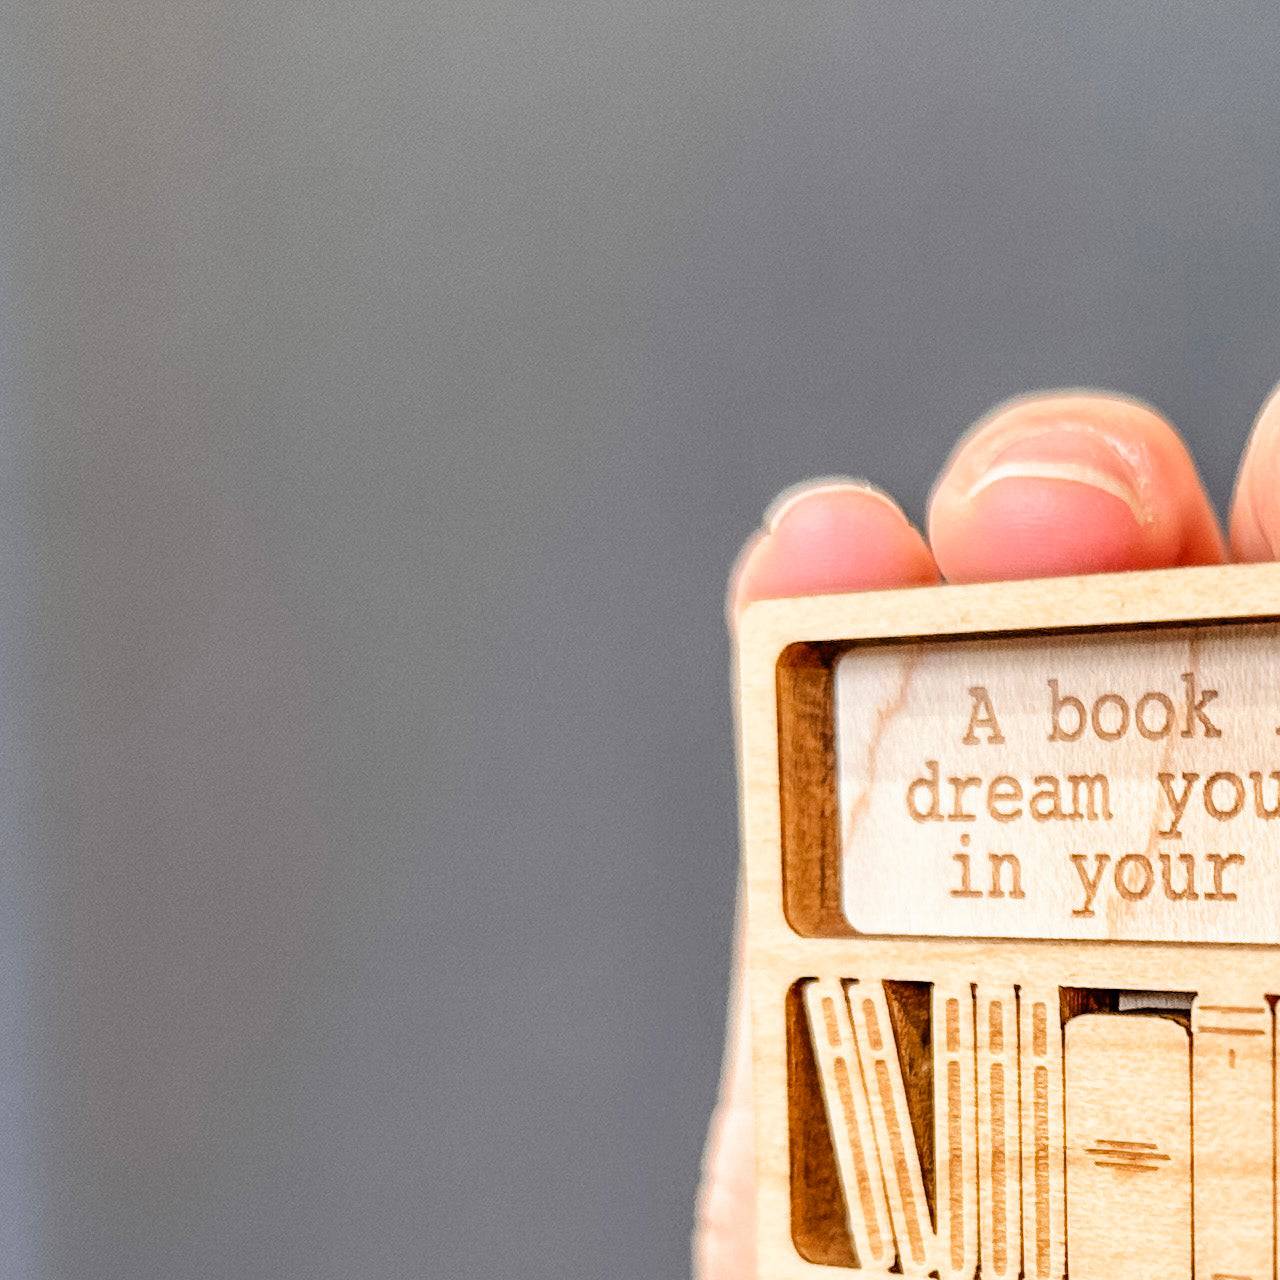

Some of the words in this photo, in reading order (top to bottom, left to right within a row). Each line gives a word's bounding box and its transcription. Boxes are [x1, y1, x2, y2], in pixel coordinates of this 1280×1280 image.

[961, 686, 1006, 746] A
[1047, 673, 1222, 744] book
[905, 760, 1114, 826] dream
[948, 834, 1026, 901] in
[1070, 844, 1246, 919] your
